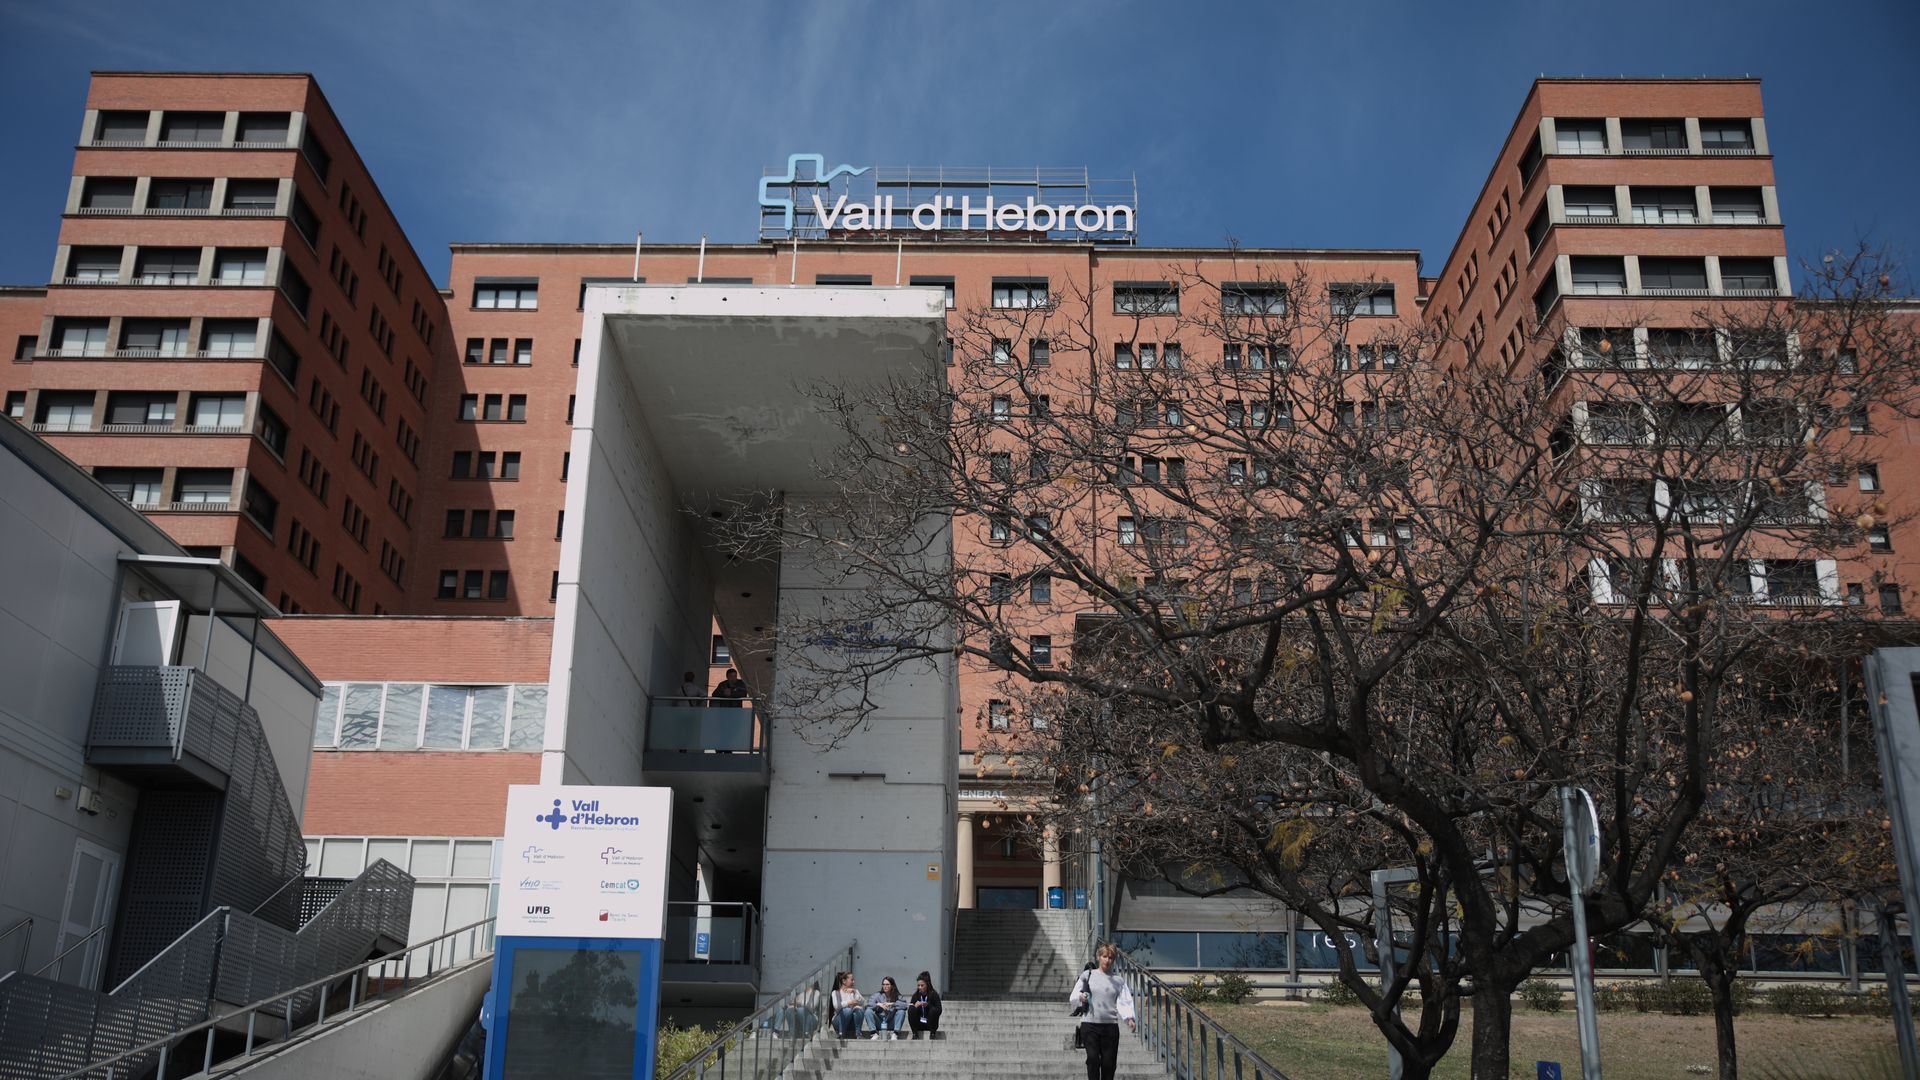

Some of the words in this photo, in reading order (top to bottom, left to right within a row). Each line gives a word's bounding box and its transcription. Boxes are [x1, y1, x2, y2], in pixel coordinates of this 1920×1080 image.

[812, 194, 893, 231] Vall
[912, 194, 1134, 232] d'Hebron
[572, 800, 599, 812] Vall
[571, 813, 639, 826] d’Hebron
[600, 880, 626, 889] Cemcat
